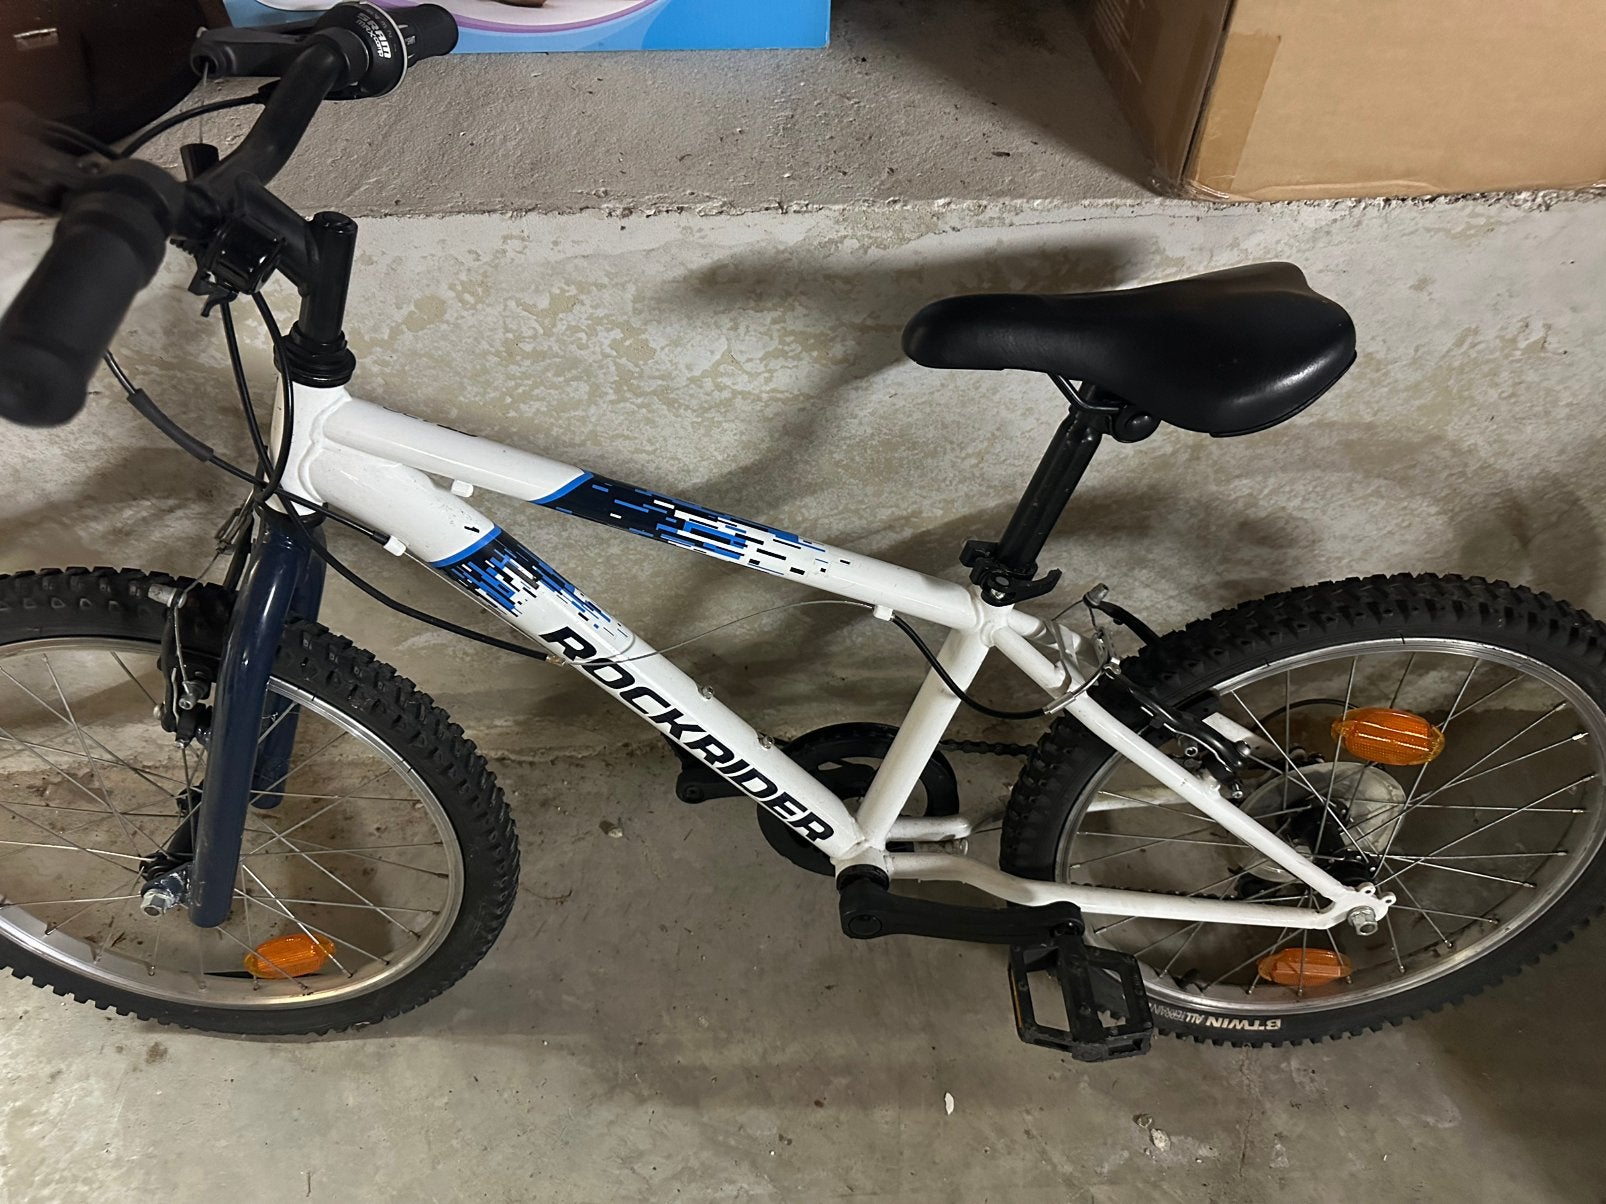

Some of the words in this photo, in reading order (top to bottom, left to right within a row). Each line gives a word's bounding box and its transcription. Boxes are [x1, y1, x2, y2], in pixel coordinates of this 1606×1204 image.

[357, 13, 392, 59] SRAM
[538, 626, 834, 842] ROCKRIDER
[1185, 1012, 1205, 1025] ALL
